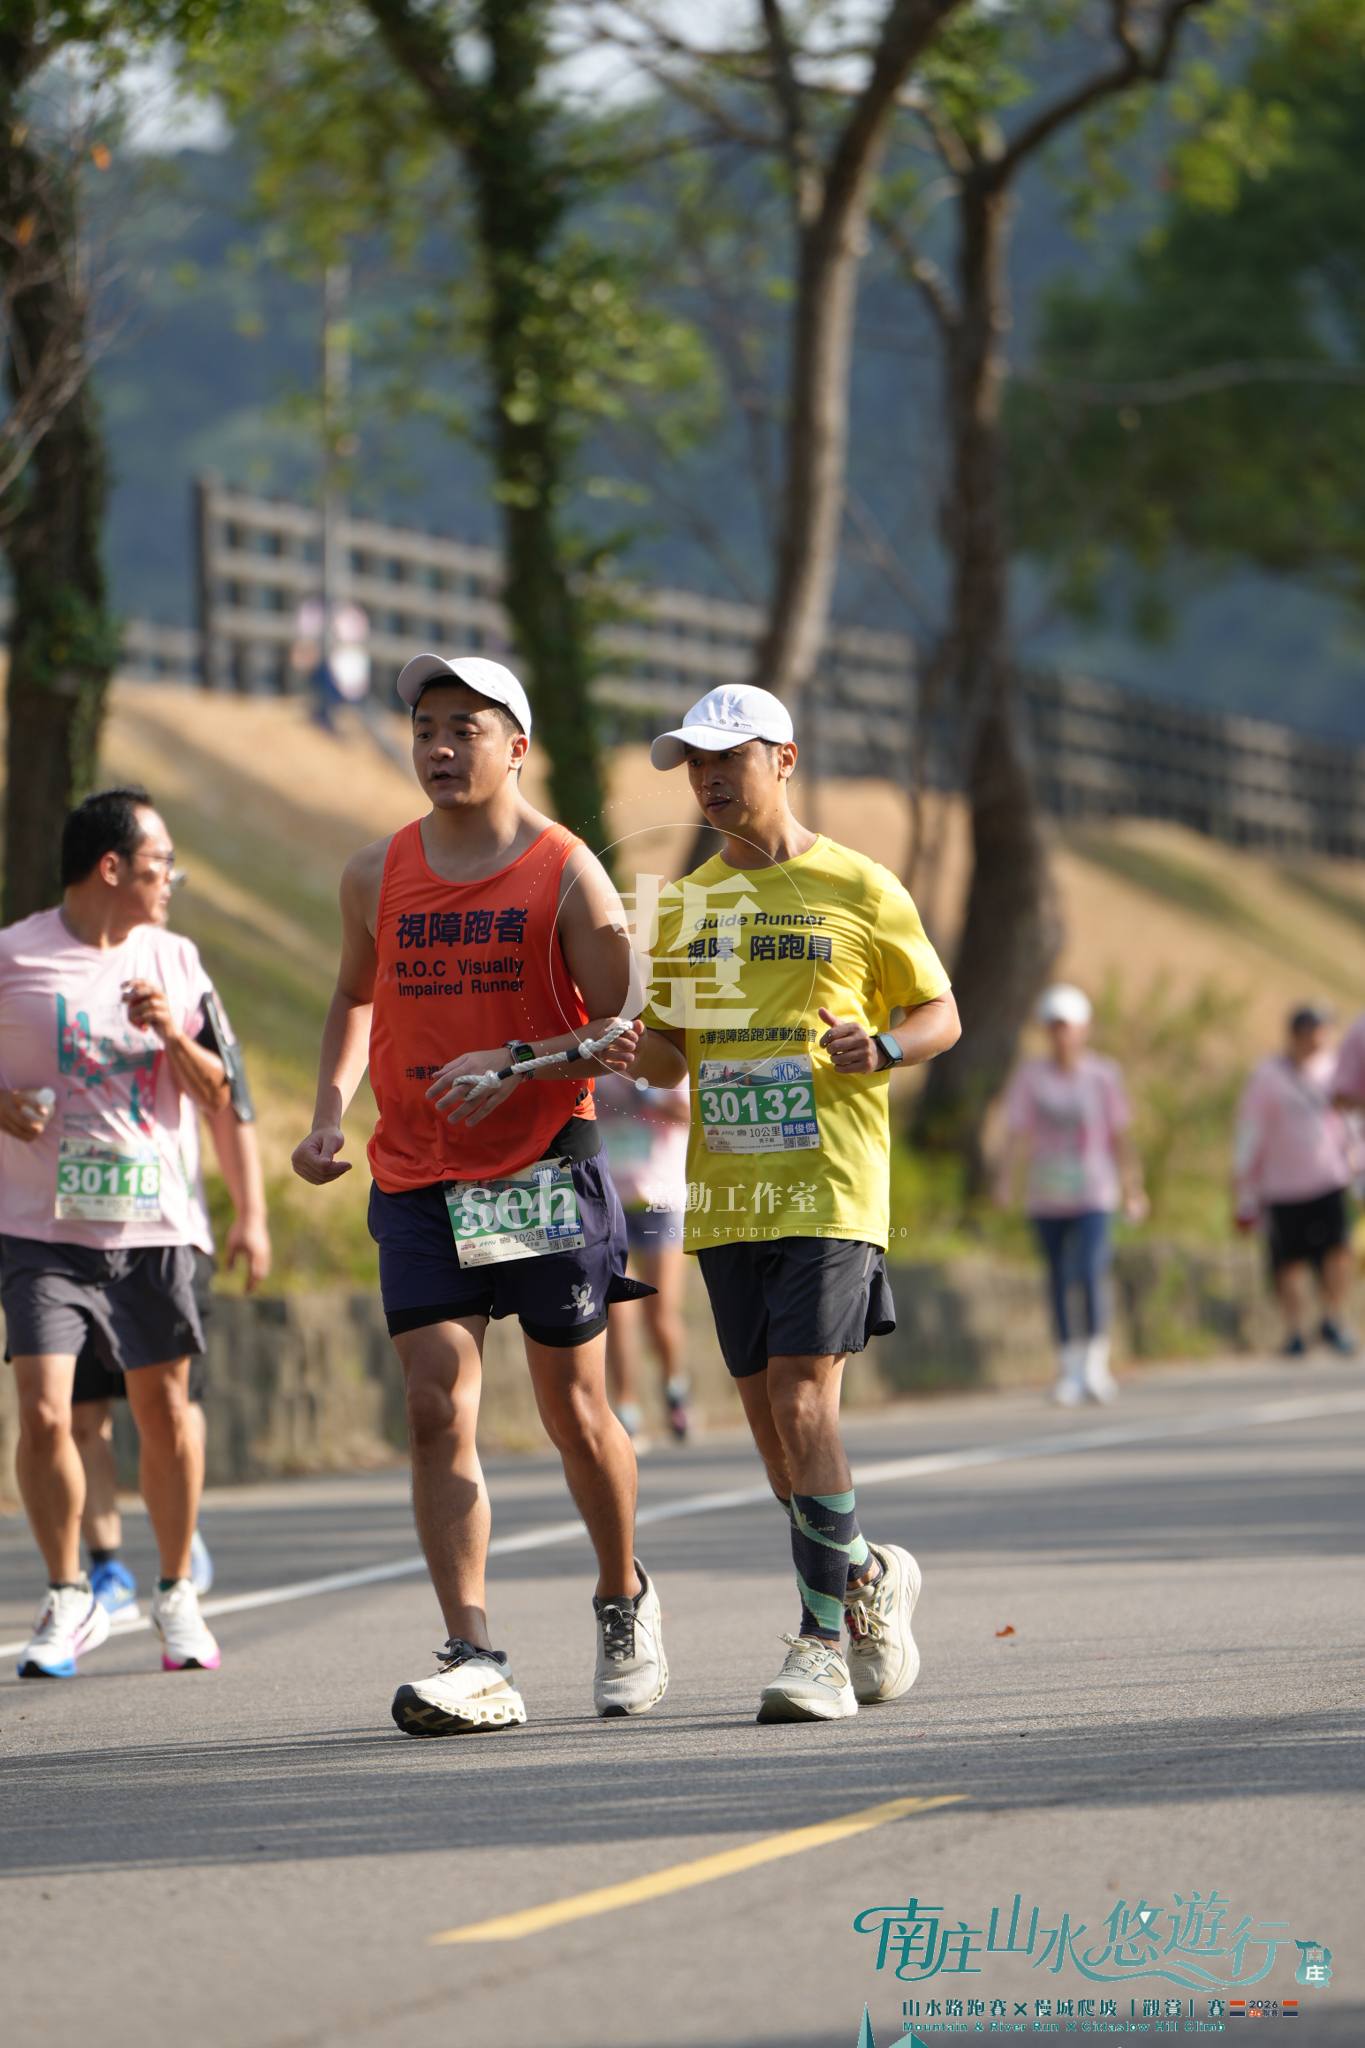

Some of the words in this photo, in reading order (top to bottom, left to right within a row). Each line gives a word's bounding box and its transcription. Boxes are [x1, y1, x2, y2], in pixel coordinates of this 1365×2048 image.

[396, 907, 528, 949] 視障跑者
[695, 914, 747, 931] Guide
[754, 912, 826, 926] Runner
[687, 937, 734, 967] 視障
[750, 934, 833, 963] 陪跑員
[396, 960, 446, 978] R.O.C
[457, 957, 525, 976] Visually
[398, 980, 463, 999] Impaired
[471, 979, 525, 993] Runner
[702, 1086, 812, 1123] 30132
[750, 1125, 781, 1138] 10公里
[61, 1164, 158, 1196] 30118
